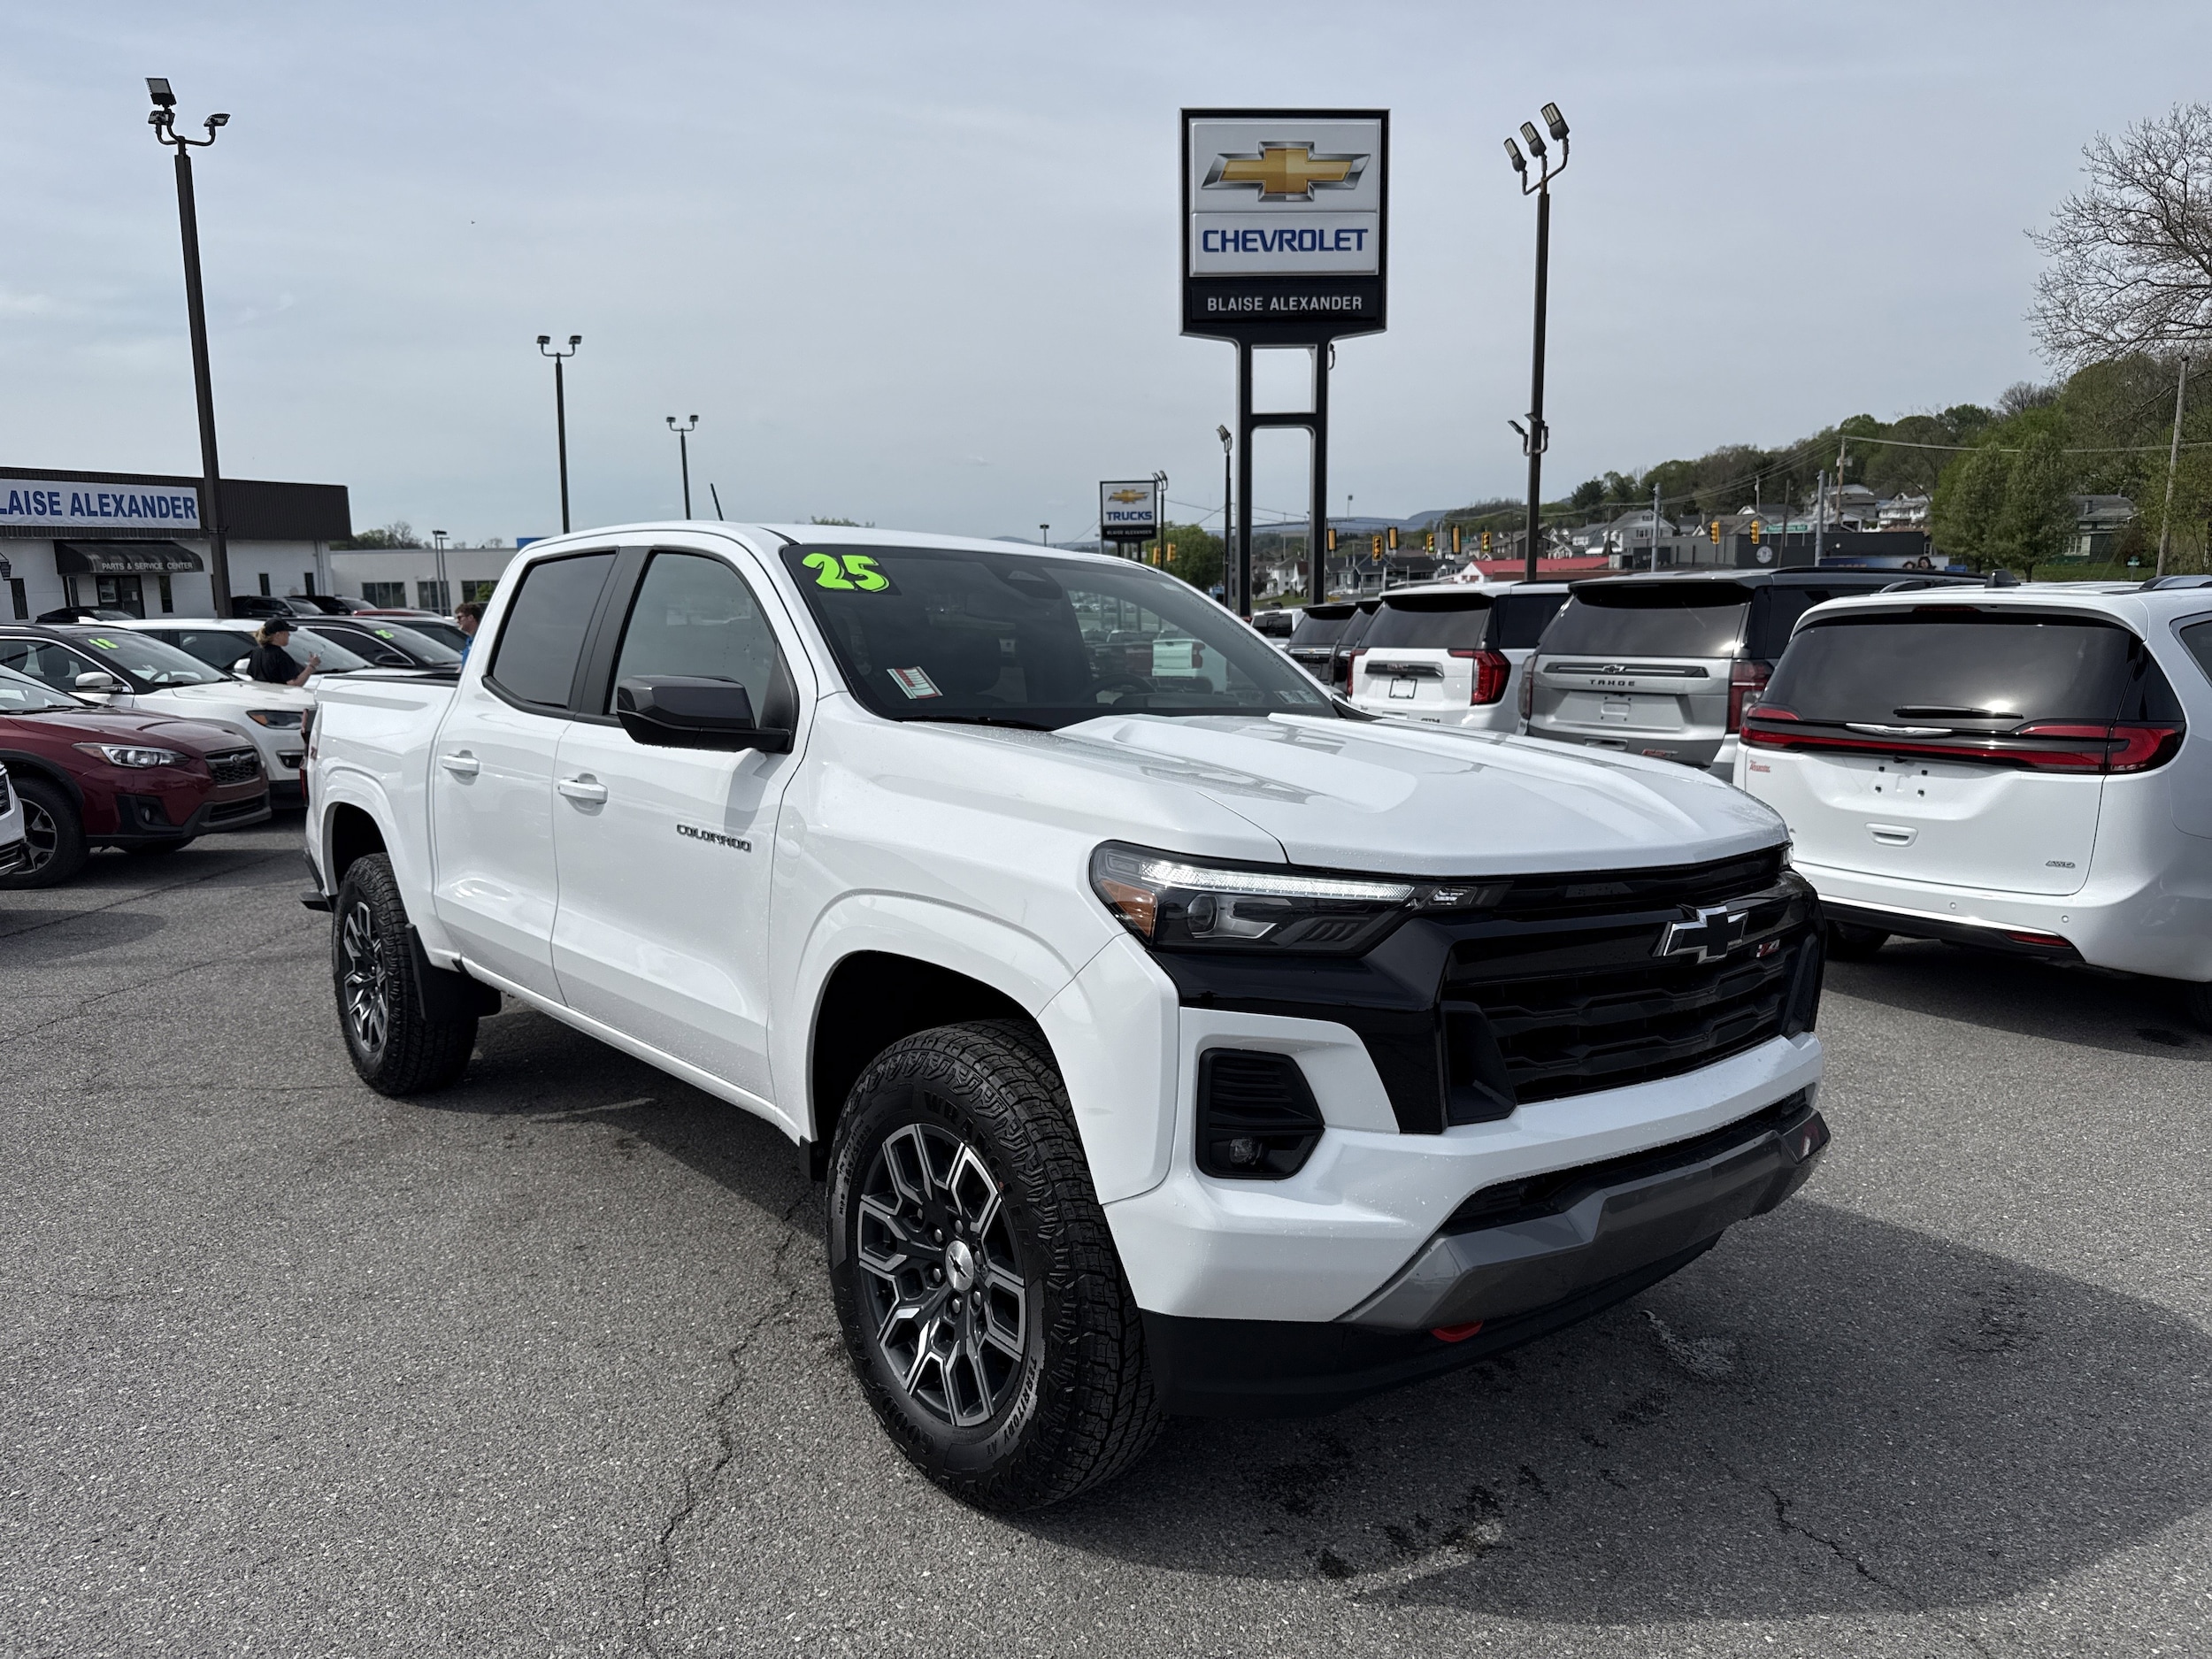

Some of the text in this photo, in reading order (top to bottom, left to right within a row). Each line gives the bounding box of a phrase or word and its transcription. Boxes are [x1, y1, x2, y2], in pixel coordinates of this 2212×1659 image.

[1202, 228, 1369, 253] CHEVROLET
[1207, 296, 1363, 311] BLAISE ALEXANDER
[70, 492, 197, 519] ALEXANDER
[1106, 511, 1153, 522] TRUCKS
[102, 562, 125, 571] PARTS
[134, 562, 164, 571] SERVICE
[166, 561, 194, 570] CENTER
[802, 552, 890, 593] 25
[1589, 679, 1636, 687] TAHOE
[676, 824, 752, 854] COLORADO
[2045, 860, 2076, 869] AWD
[1003, 1356, 1038, 1445] TERRITORY
